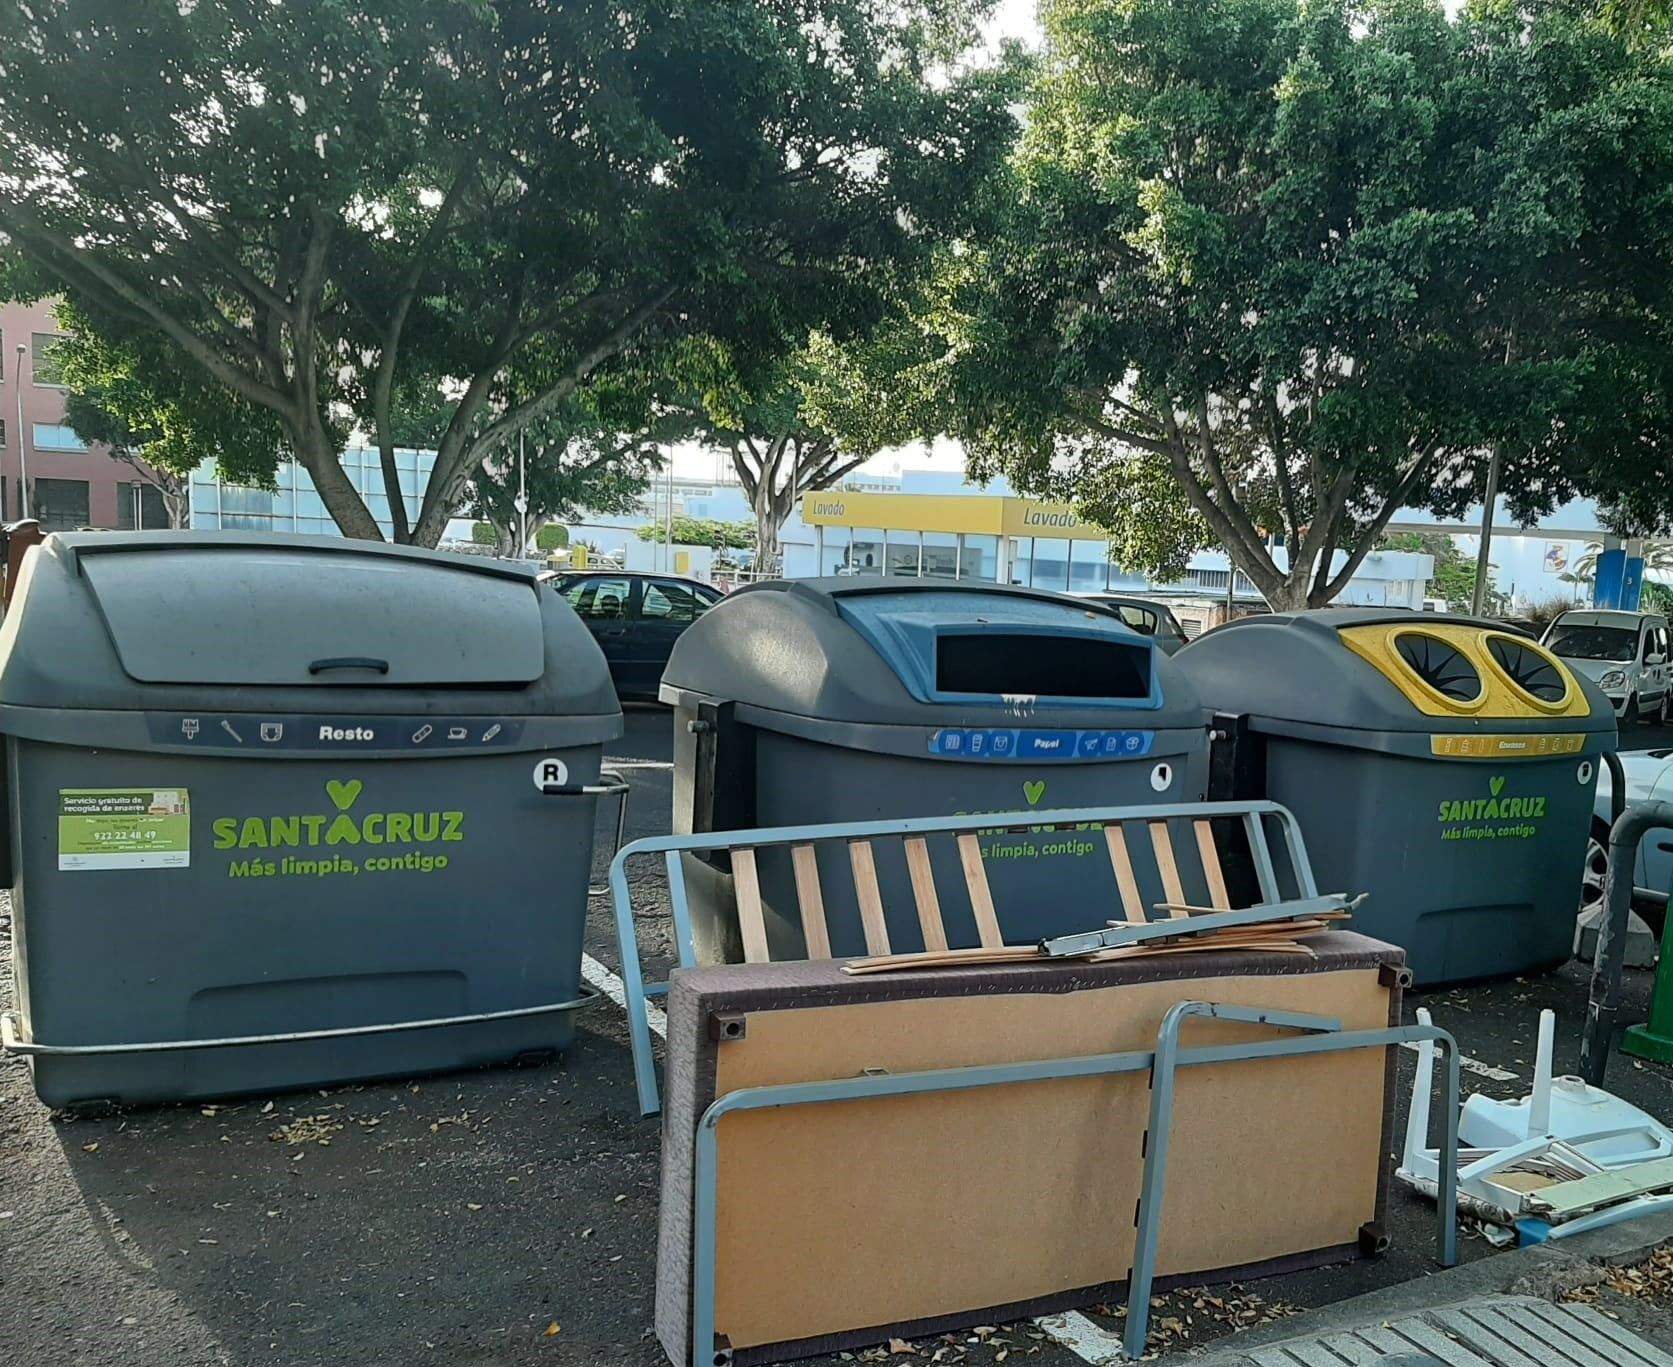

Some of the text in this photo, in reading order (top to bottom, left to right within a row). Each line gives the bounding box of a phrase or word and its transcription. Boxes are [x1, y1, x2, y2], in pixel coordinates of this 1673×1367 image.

[813, 499, 845, 517] Lavado
[1024, 507, 1077, 528] Lavado
[319, 726, 374, 741] Resto
[1034, 737, 1060, 749] Papel
[543, 764, 559, 782] R
[63, 796, 143, 806] Servicio gratuito de
[64, 805, 100, 813] recogida
[94, 832, 112, 841] 922
[114, 831, 127, 840] 22
[212, 811, 464, 849] SANTACRUZ
[1441, 823, 1536, 840] Más limpia, contigo
[992, 842, 1038, 859] limpia,
[1042, 839, 1093, 856] contigo
[229, 851, 448, 877] Más limpia, contigo
